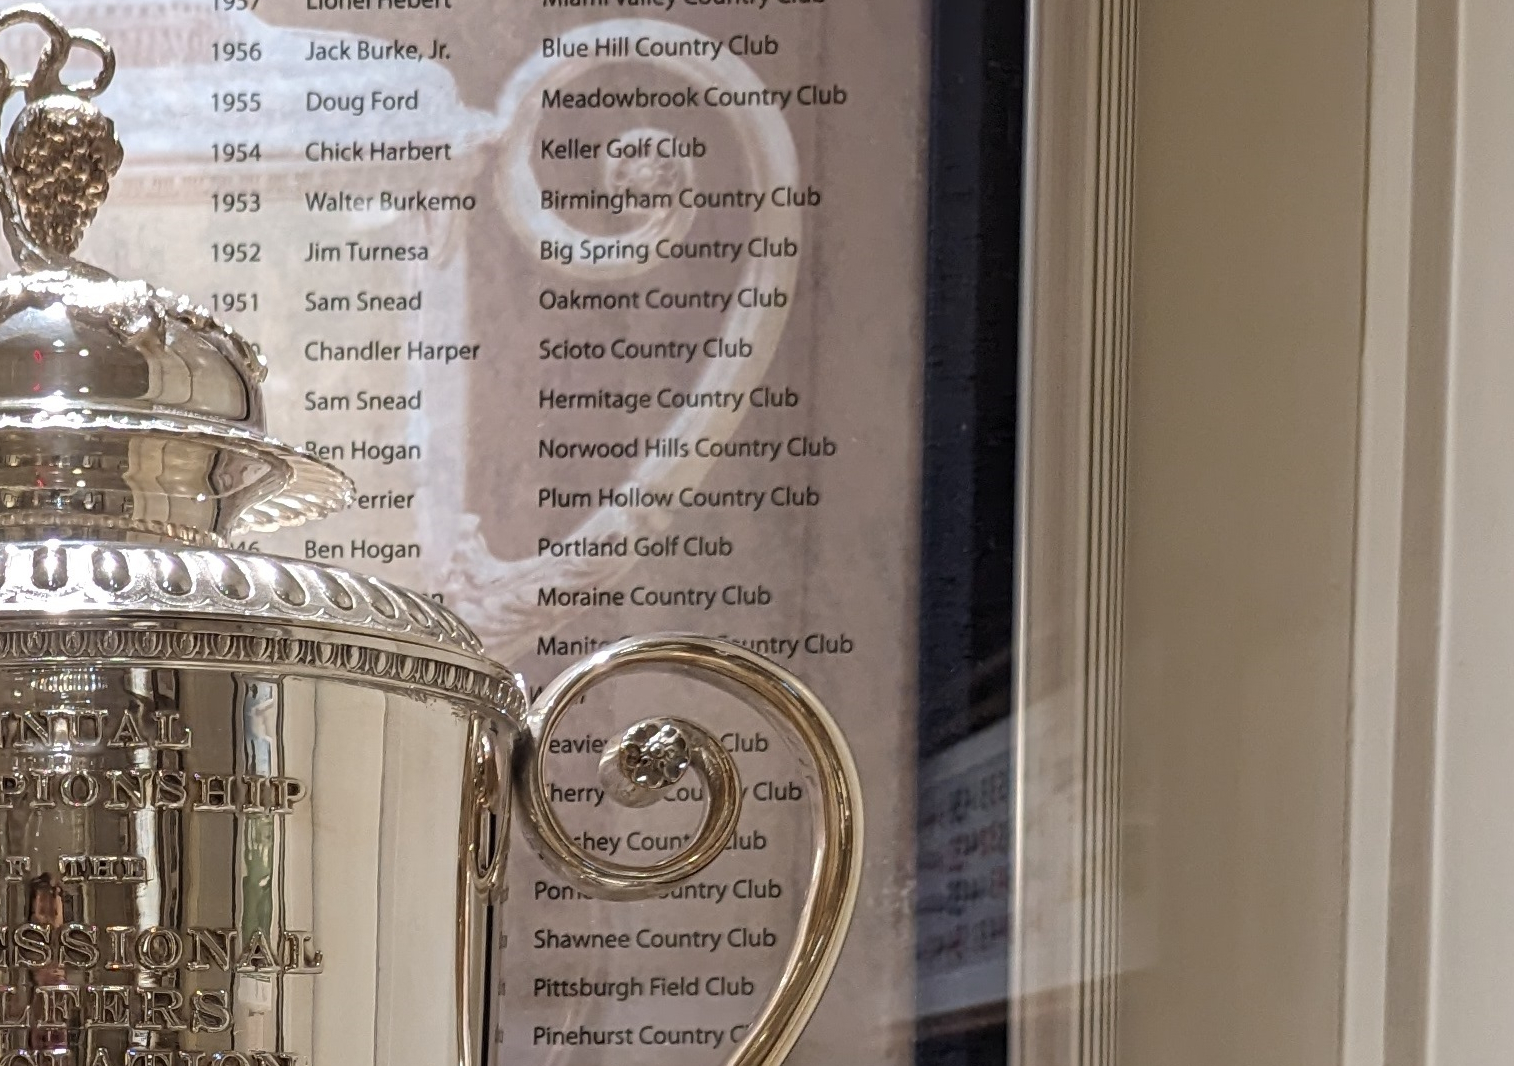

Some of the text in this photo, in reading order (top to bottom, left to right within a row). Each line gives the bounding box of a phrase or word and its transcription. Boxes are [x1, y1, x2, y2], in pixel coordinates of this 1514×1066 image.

[211, 34, 779, 63] 1956 Jack Burke, Jr. Blue Hill Country Club
[211, 84, 848, 117] 1955 Doug Ford Meadowbrook Country Club
[211, 136, 707, 163] 1954 Chick Harbert Keller Golf Club
[211, 236, 798, 266] 1952 Jim Turnesa Big Spring Country Club
[59, 855, 147, 882] THE
[533, 975, 755, 1002] Pittsburgh Field Club
